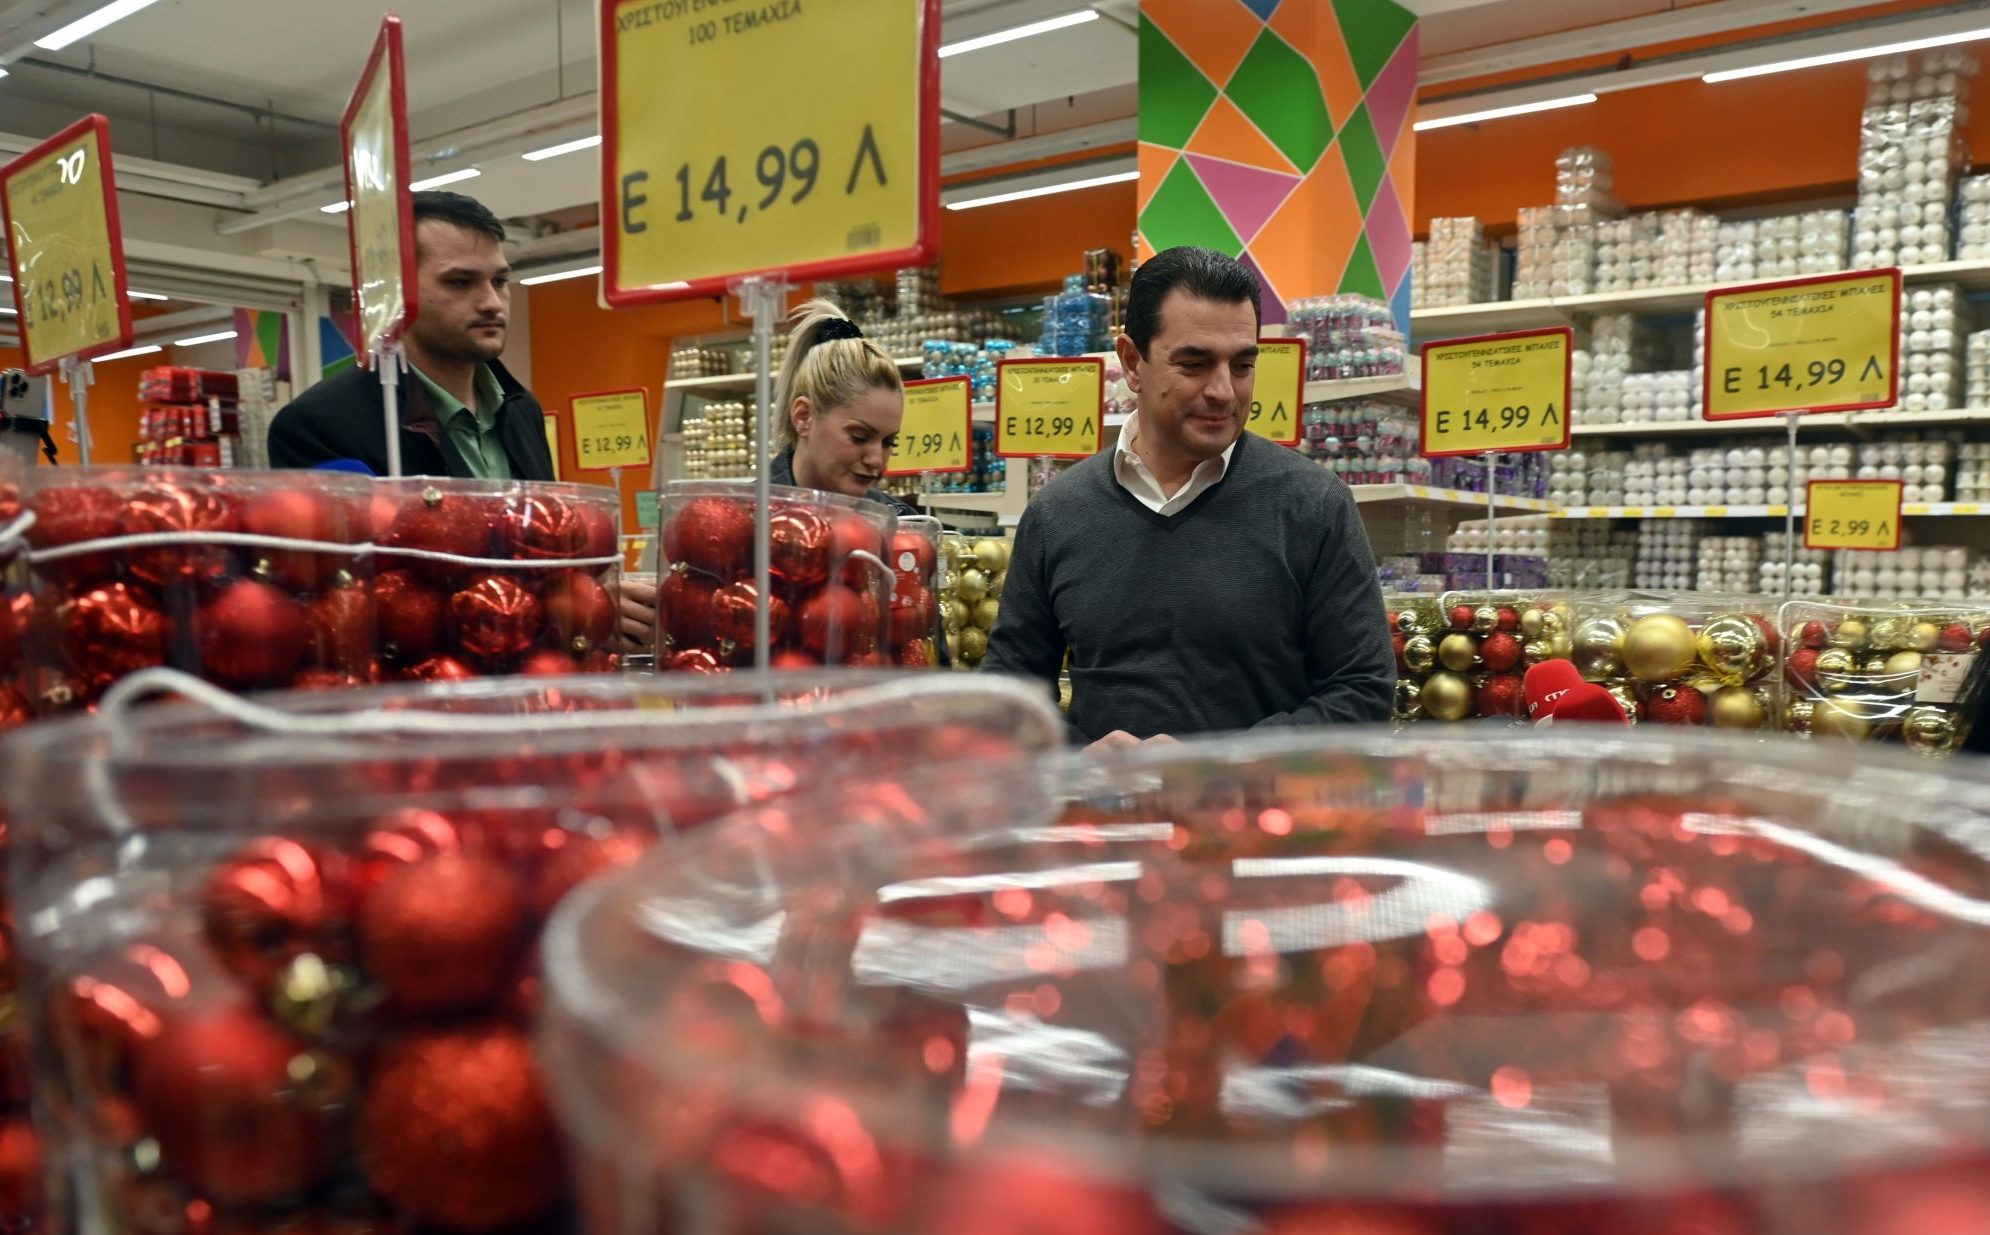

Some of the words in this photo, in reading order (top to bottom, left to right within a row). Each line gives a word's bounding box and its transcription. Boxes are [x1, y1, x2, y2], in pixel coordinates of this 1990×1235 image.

[688, 20, 717, 45] 100
[722, 0, 803, 34] ΤΕΜΑΧΙΑ
[675, 138, 820, 224] 14,99
[1758, 359, 1845, 391] 14,99
[1025, 417, 1074, 438] 12,99
[1463, 405, 1530, 433] 14,99
[595, 435, 631, 453] 12,99
[906, 433, 942, 457] 7,99
[1830, 520, 1869, 537] 2,99
